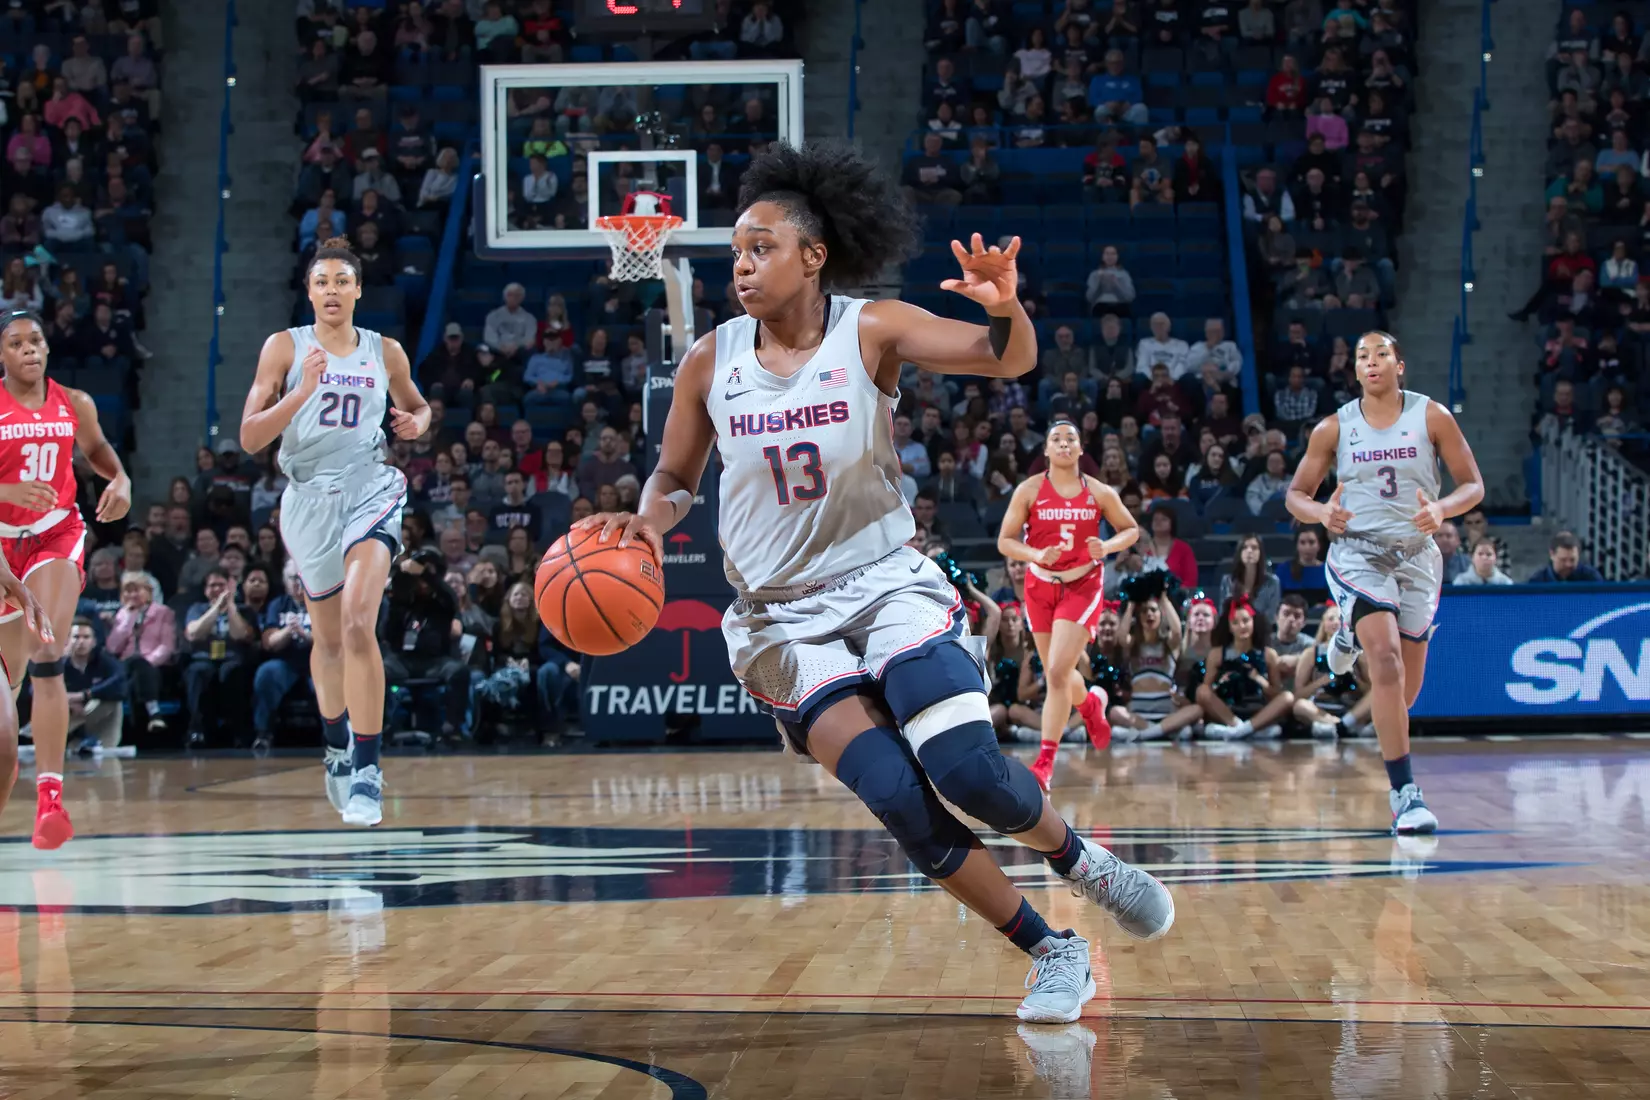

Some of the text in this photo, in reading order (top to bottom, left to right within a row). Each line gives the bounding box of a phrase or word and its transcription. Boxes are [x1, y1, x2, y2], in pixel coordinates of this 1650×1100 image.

[320, 373, 375, 389] USKIES
[651, 376, 674, 390] SPA
[319, 392, 361, 429] 20
[729, 400, 850, 437] HUSKIES
[0, 422, 74, 441] HOUSTON
[20, 442, 60, 482] 30
[1352, 446, 1417, 463] HUSKIES
[762, 441, 828, 506] 13
[1377, 465, 1398, 499] 3
[1036, 508, 1097, 521] HOUSTON
[1060, 523, 1077, 552] 5
[663, 553, 706, 564] RAVELERS
[802, 583, 826, 595] UCONN
[1504, 637, 1650, 705] SN
[587, 684, 760, 715] TRAVELER
